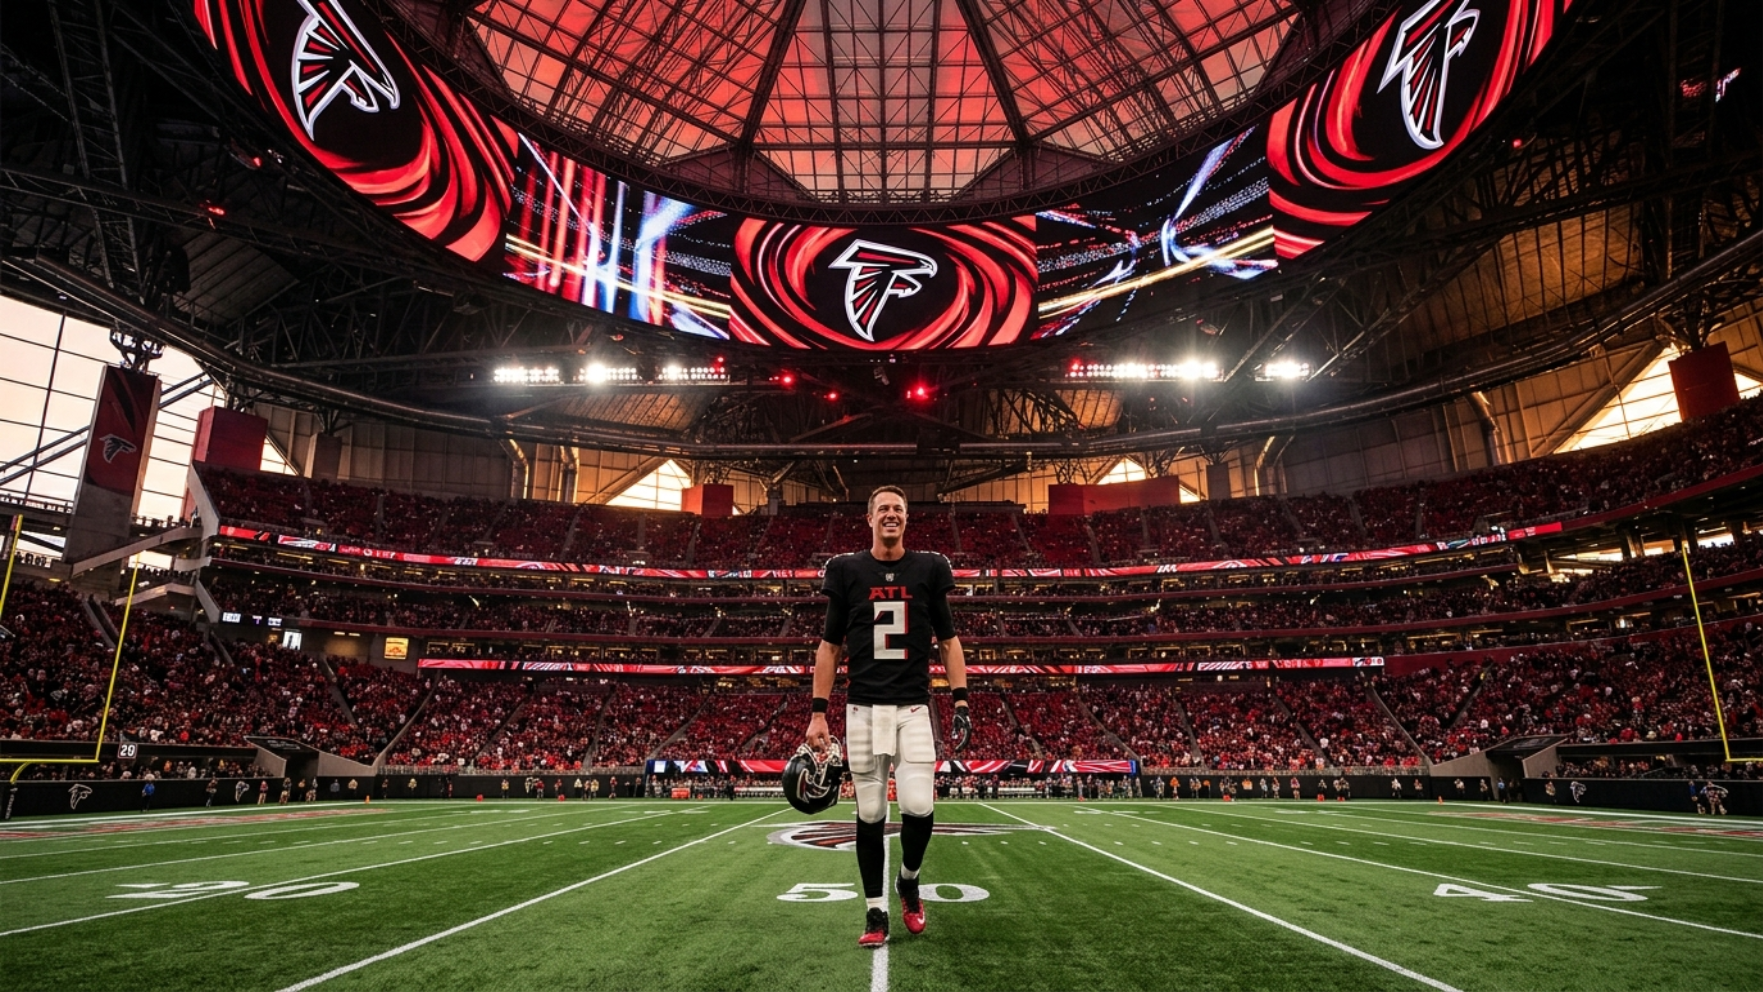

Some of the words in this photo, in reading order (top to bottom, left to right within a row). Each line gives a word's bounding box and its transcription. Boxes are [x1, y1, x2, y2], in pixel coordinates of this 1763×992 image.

[868, 586, 913, 600] ATL
[873, 601, 909, 659] 2
[776, 883, 990, 902] 50
[1433, 883, 1648, 902] 40
